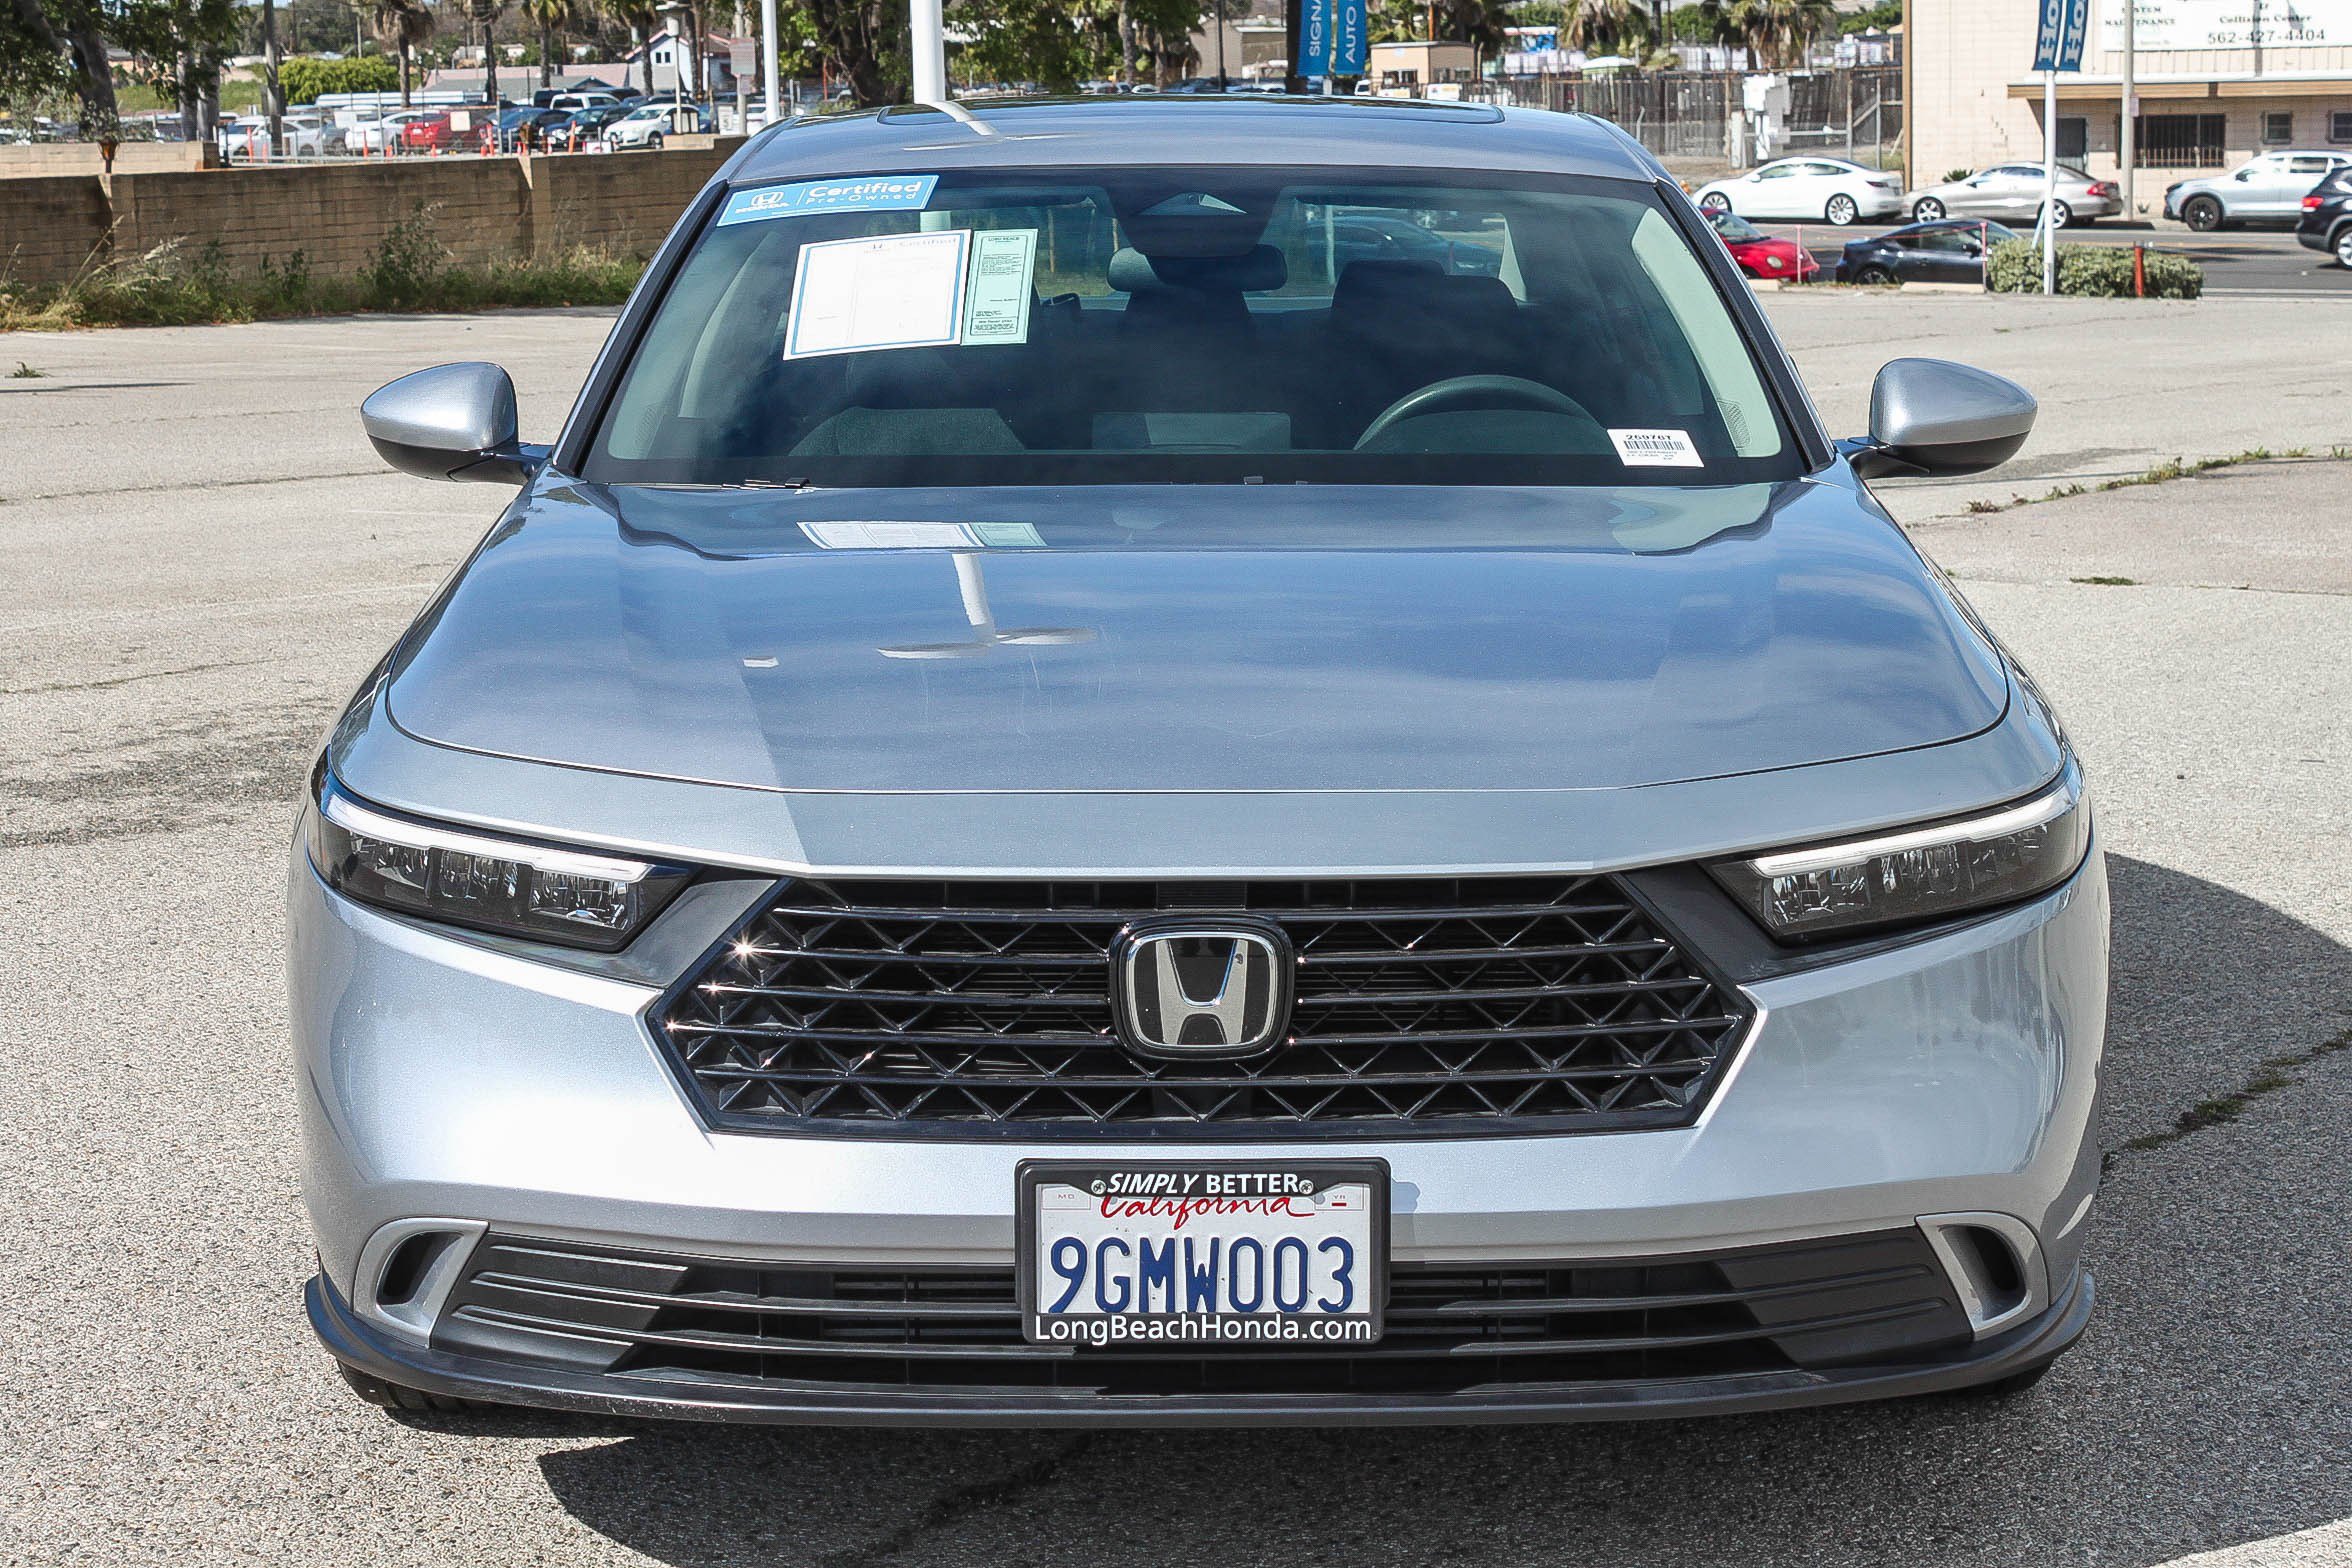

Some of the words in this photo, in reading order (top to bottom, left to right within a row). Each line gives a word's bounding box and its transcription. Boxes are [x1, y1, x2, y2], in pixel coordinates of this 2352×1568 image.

[2219, 14, 2270, 24] Collision
[2274, 13, 2312, 22] Center
[1345, 6, 1358, 64] AUTO
[2207, 29, 2326, 44] 562-427-4404
[805, 191, 917, 205] Pre-Owned
[808, 181, 922, 198] Certified
[1107, 1173, 1200, 1195] SIMPLY
[1205, 1173, 1300, 1194] BETTER
[1100, 1195, 1315, 1231] California
[1048, 1237, 1354, 1314] 9GMW003
[1036, 1313, 1372, 1346] LongBeachHonda.com
